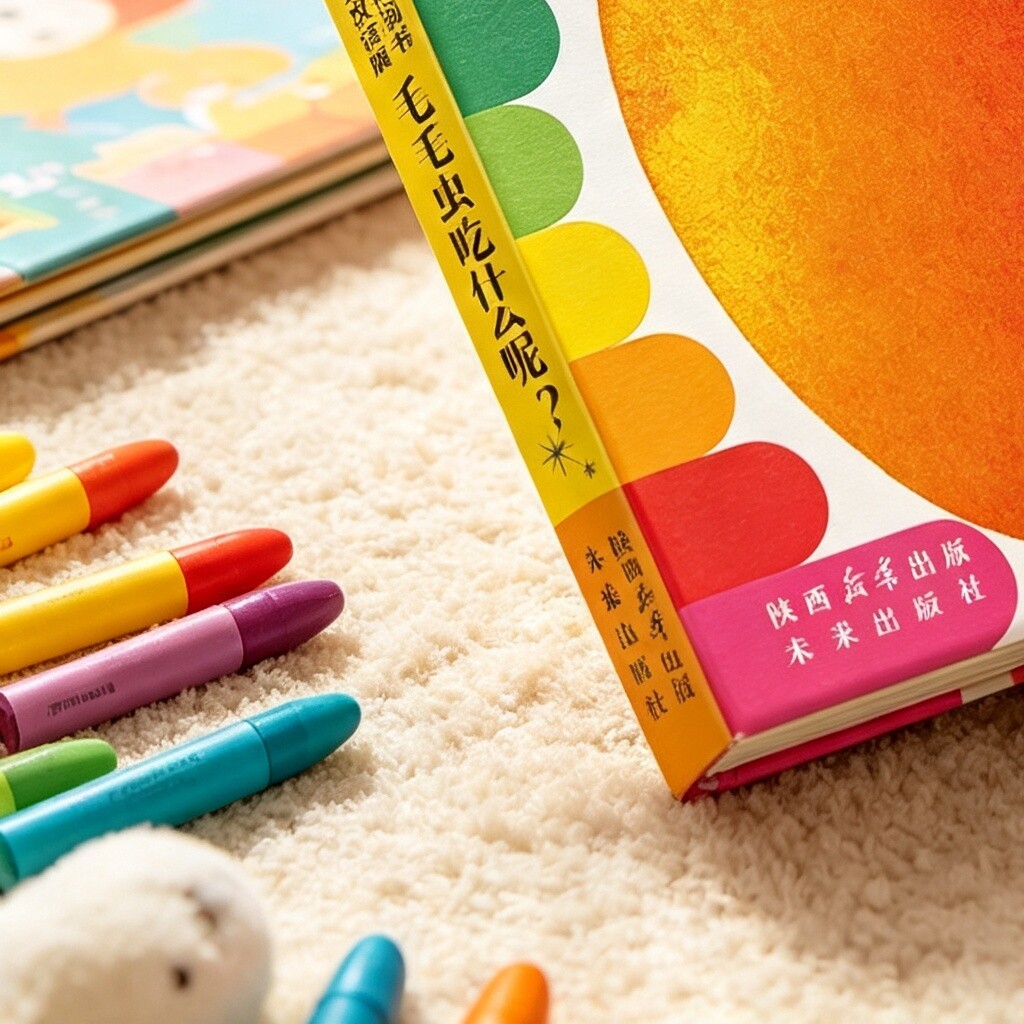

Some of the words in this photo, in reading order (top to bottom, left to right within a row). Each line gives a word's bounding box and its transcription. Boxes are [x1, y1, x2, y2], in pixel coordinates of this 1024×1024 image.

[392, 74, 560, 434] 毛毛虫吃什么呢?
